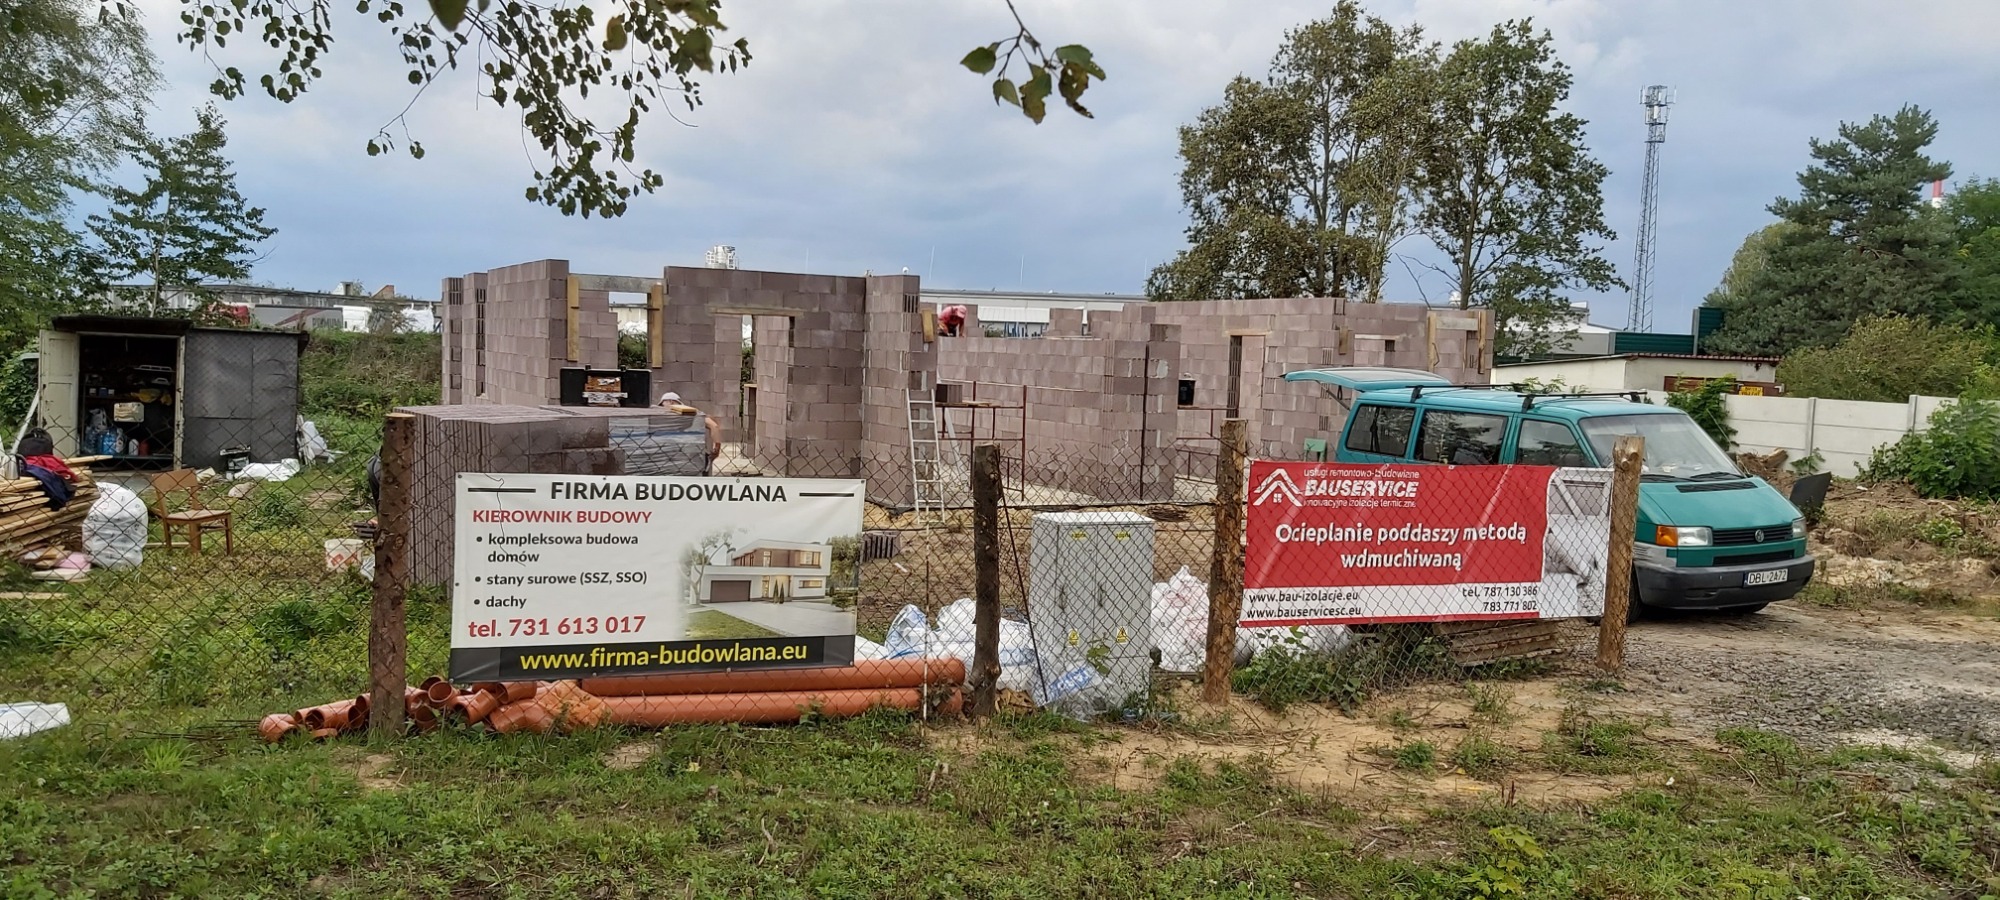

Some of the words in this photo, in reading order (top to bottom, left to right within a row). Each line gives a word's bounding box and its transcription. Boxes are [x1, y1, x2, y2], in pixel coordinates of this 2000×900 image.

[550, 482, 629, 501] FIRMA
[635, 483, 788, 502] BUDOWLANA
[1304, 479, 1419, 498] BAUSERVICE
[472, 509, 573, 523] KIEROWNIK
[576, 510, 653, 524] BUDOWY
[488, 533, 583, 547] kompleksowa
[586, 533, 639, 545] budowa
[1275, 522, 1374, 546] Ocieplanie
[1377, 522, 1460, 546] poddaszy
[1462, 521, 1528, 545] metodą
[487, 550, 540, 563] domów
[1340, 548, 1463, 572] wdmuchiwaną
[486, 573, 525, 587] stany
[527, 574, 577, 585] surowe
[579, 571, 613, 586] (SSZ,
[615, 571, 648, 585] SSO)
[1749, 572, 1766, 584] DBL
[1249, 589, 1360, 603] www.bau-izolacje.eu
[1462, 586, 1480, 598] tel.
[1483, 586, 1501, 597] 787
[1505, 586, 1521, 597] 130
[1522, 585, 1538, 596] 386
[485, 595, 527, 609] dachy
[1483, 601, 1501, 612] 783
[1503, 600, 1520, 612] 771
[1522, 600, 1537, 611] 802
[1246, 605, 1362, 618] www.bauservicesc.eu
[468, 619, 502, 638] tel.
[509, 618, 550, 637] 731
[557, 617, 599, 635] 613
[605, 615, 647, 634] 017
[520, 642, 808, 670] www.firma-budowlana.eu
